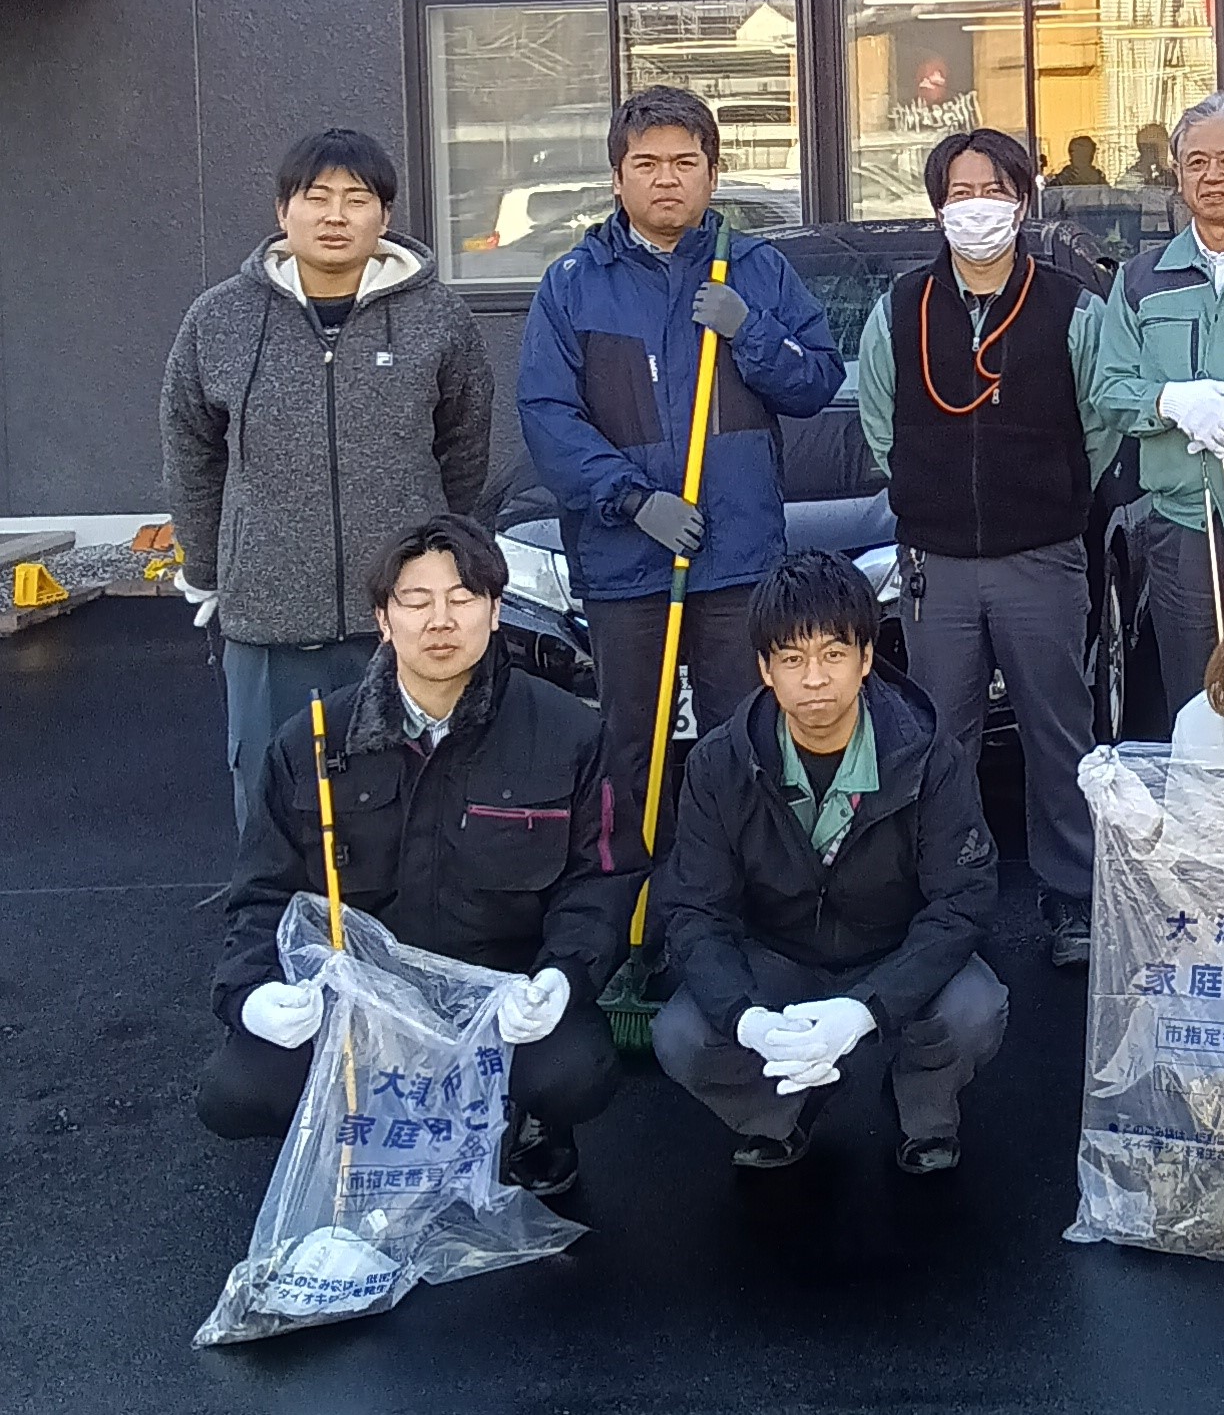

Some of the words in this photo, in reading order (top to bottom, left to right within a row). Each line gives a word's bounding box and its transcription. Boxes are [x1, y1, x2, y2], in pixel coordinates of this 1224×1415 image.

[350, 1167, 446, 1190] 市指定番号
